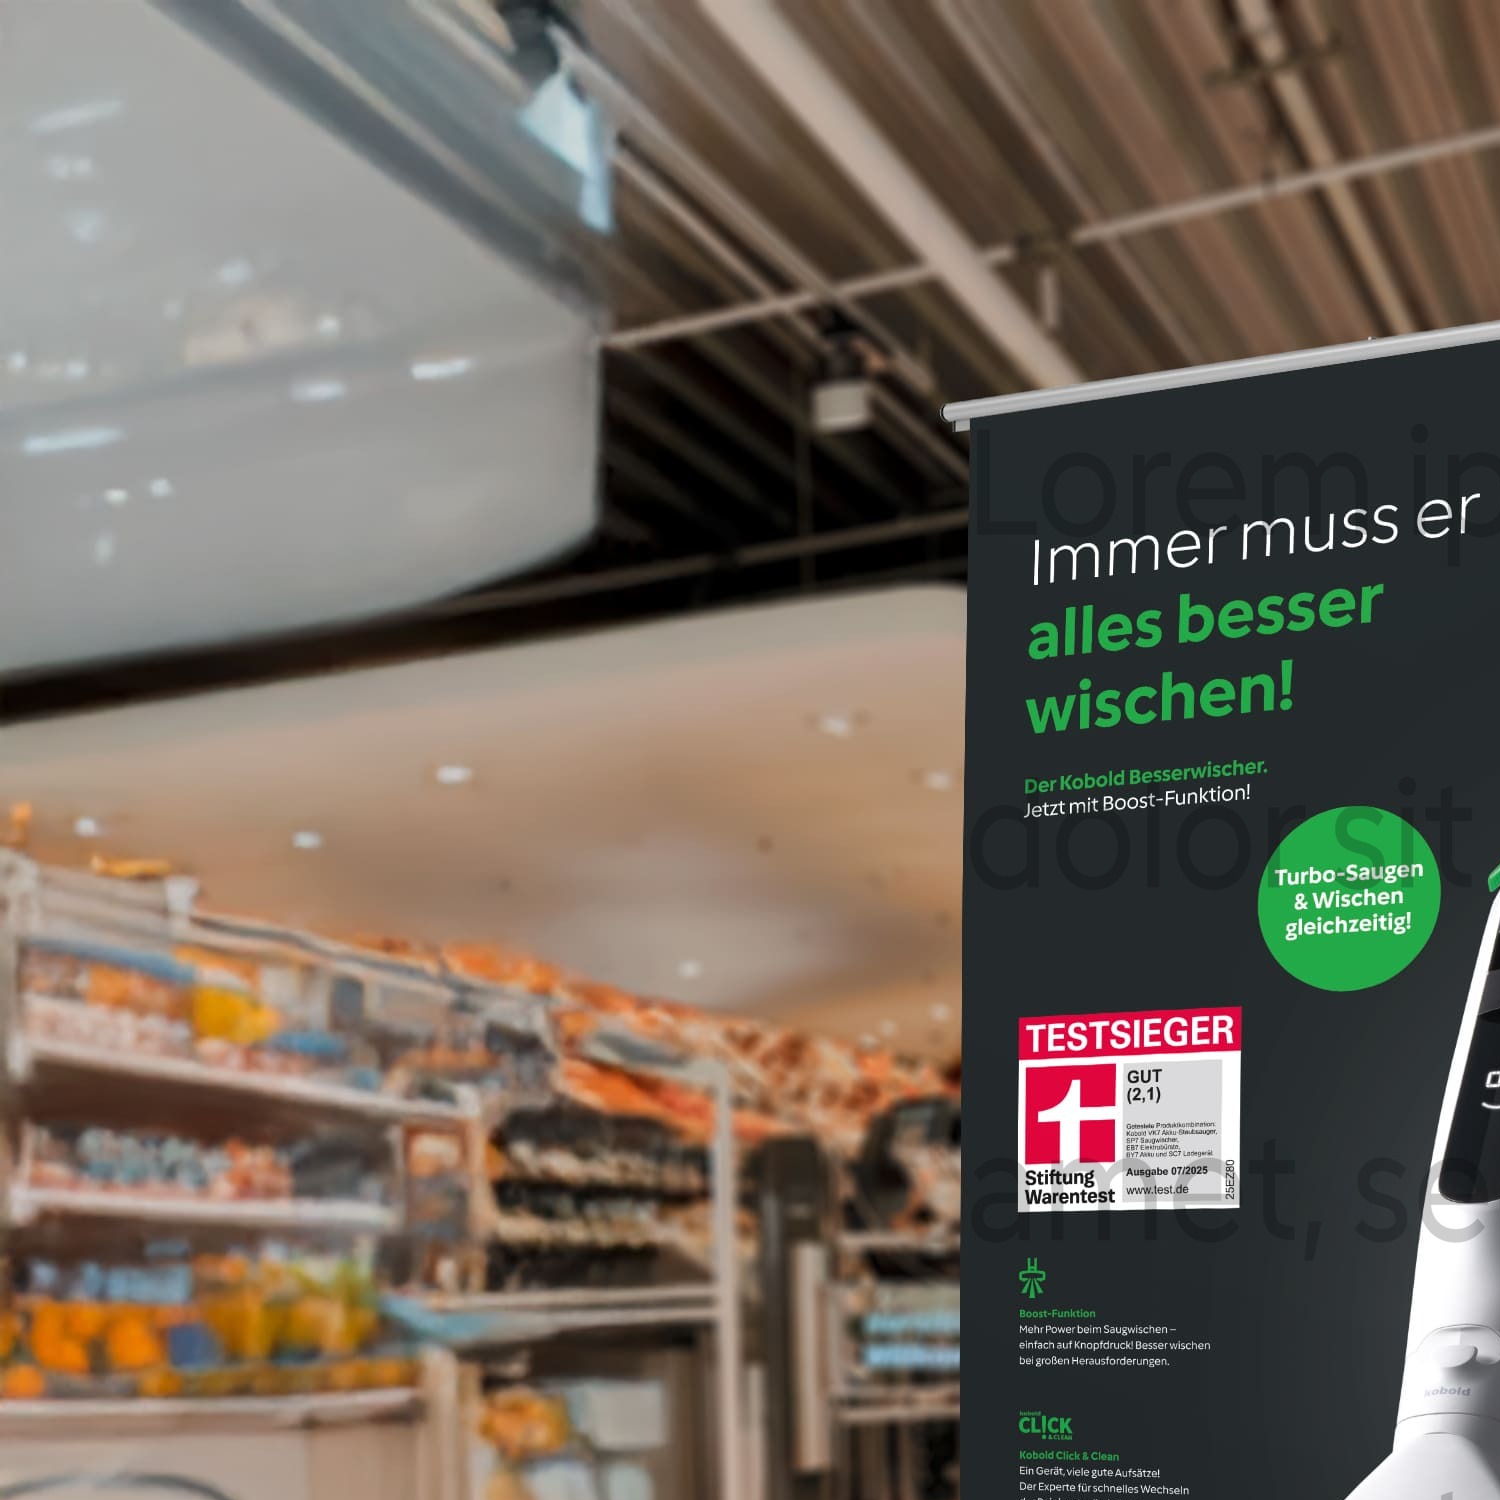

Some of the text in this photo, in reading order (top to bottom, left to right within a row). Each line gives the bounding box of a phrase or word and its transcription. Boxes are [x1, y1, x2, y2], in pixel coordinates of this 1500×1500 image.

[974, 428, 1370, 537] Lorem
[1032, 493, 1481, 586] Immer muss er
[1027, 583, 1384, 661] alles besser
[1025, 659, 1294, 734] wischen!
[1024, 760, 1268, 794] Der Kobold Besserwischer.
[1024, 784, 1251, 818] Jetzt mit Boost-Funktion!
[968, 778, 1306, 893] dolor
[1332, 776, 1474, 893] sit
[1274, 863, 1424, 886] Turbo-Saugen
[1294, 888, 1404, 910] & Wischen
[1285, 912, 1412, 941] gleichzeitig!
[1025, 1015, 1234, 1053] TESTSIEGER
[1127, 1069, 1162, 1084] GUT
[1127, 1087, 1161, 1104] (2,1)
[1025, 1169, 1094, 1187] Stiftung
[1126, 1165, 1208, 1177] Ausgabe 07/2025
[1025, 1189, 1115, 1205] Warentest
[1126, 1184, 1189, 1195] www.test.de
[968, 1142, 1322, 1262] amet,
[1019, 1309, 1096, 1318] Boost-Funktion
[1019, 1324, 1044, 1334] Mehr
[1045, 1325, 1076, 1334] Power
[1077, 1324, 1102, 1334] beim
[1104, 1324, 1168, 1336] Saugwischen
[1019, 1340, 1211, 1353] einfach auf Knopfdruck! Besser wischen
[1019, 1356, 1170, 1368] bei großen Herausforderungen.
[1424, 1386, 1471, 1397] kobold
[1019, 1450, 1120, 1461] Kobold Click & Clean
[1019, 1466, 1161, 1479] Ein Gerät, viele gute Aufsätze!
[1019, 1482, 1189, 1495] Der Experte für schnelles Wechseln
